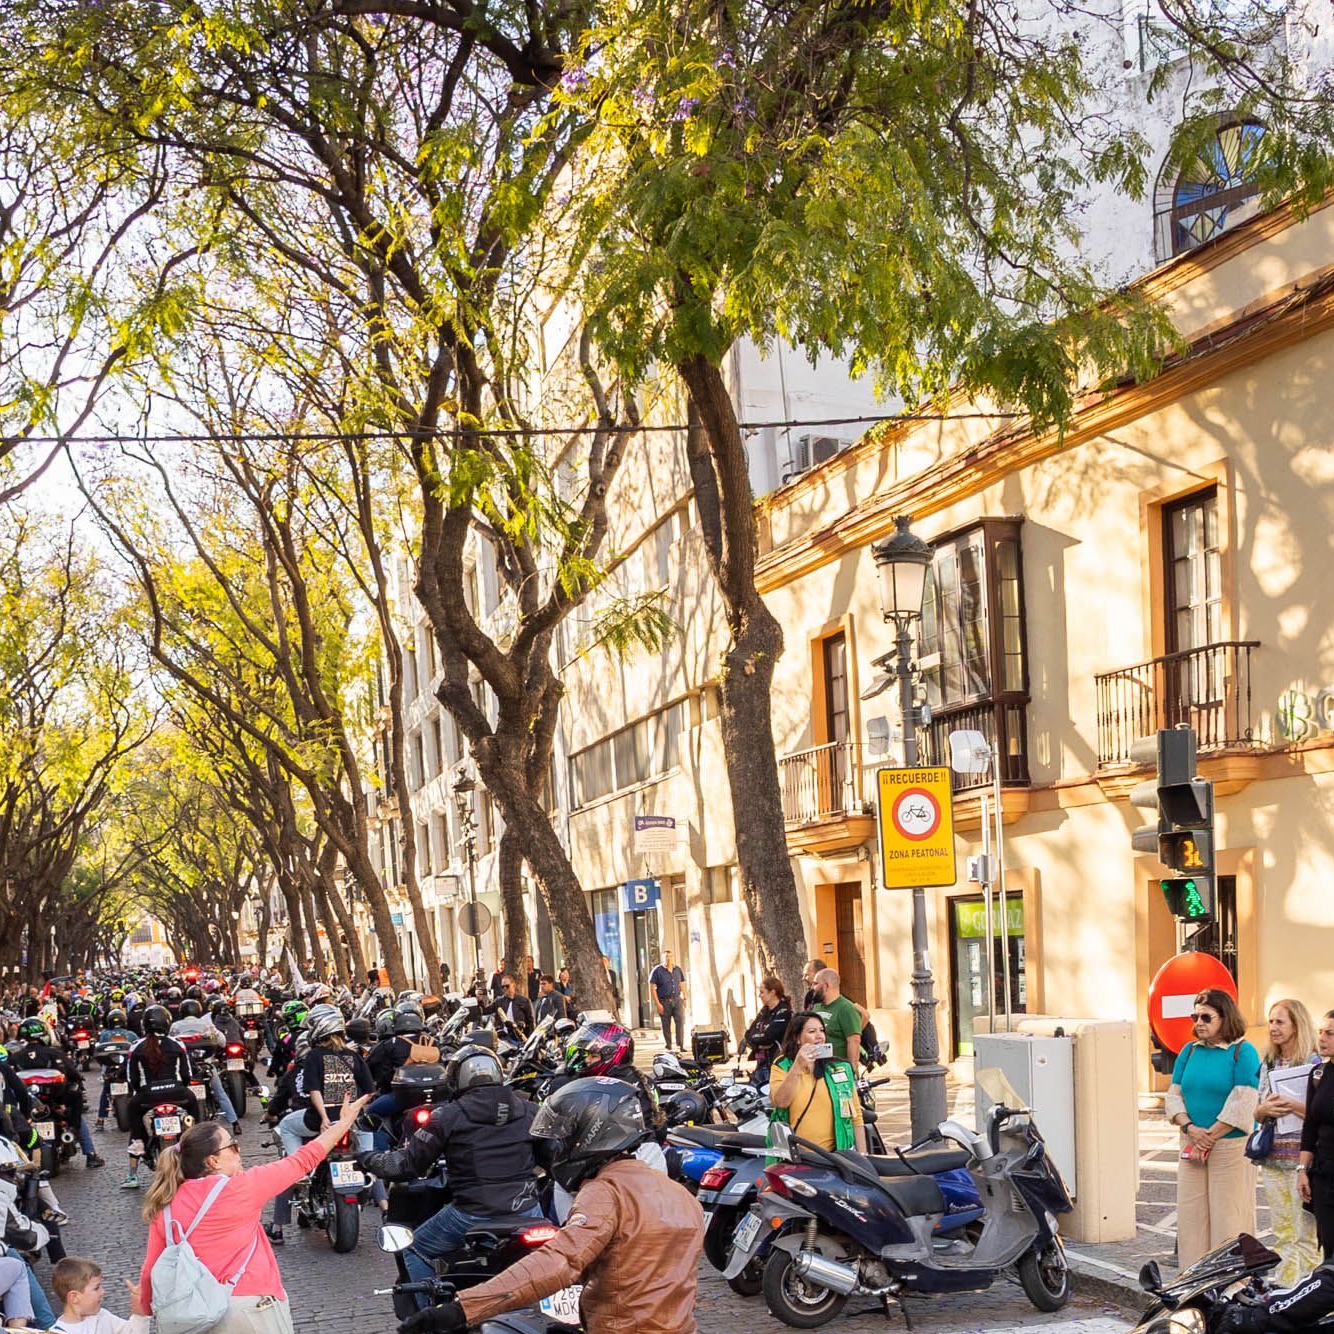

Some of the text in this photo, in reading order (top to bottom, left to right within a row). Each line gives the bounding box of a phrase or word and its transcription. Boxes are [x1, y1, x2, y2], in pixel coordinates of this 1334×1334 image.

[889, 847, 949, 860] ZONA PEATONAL
[554, 1301, 579, 1318] MDK
